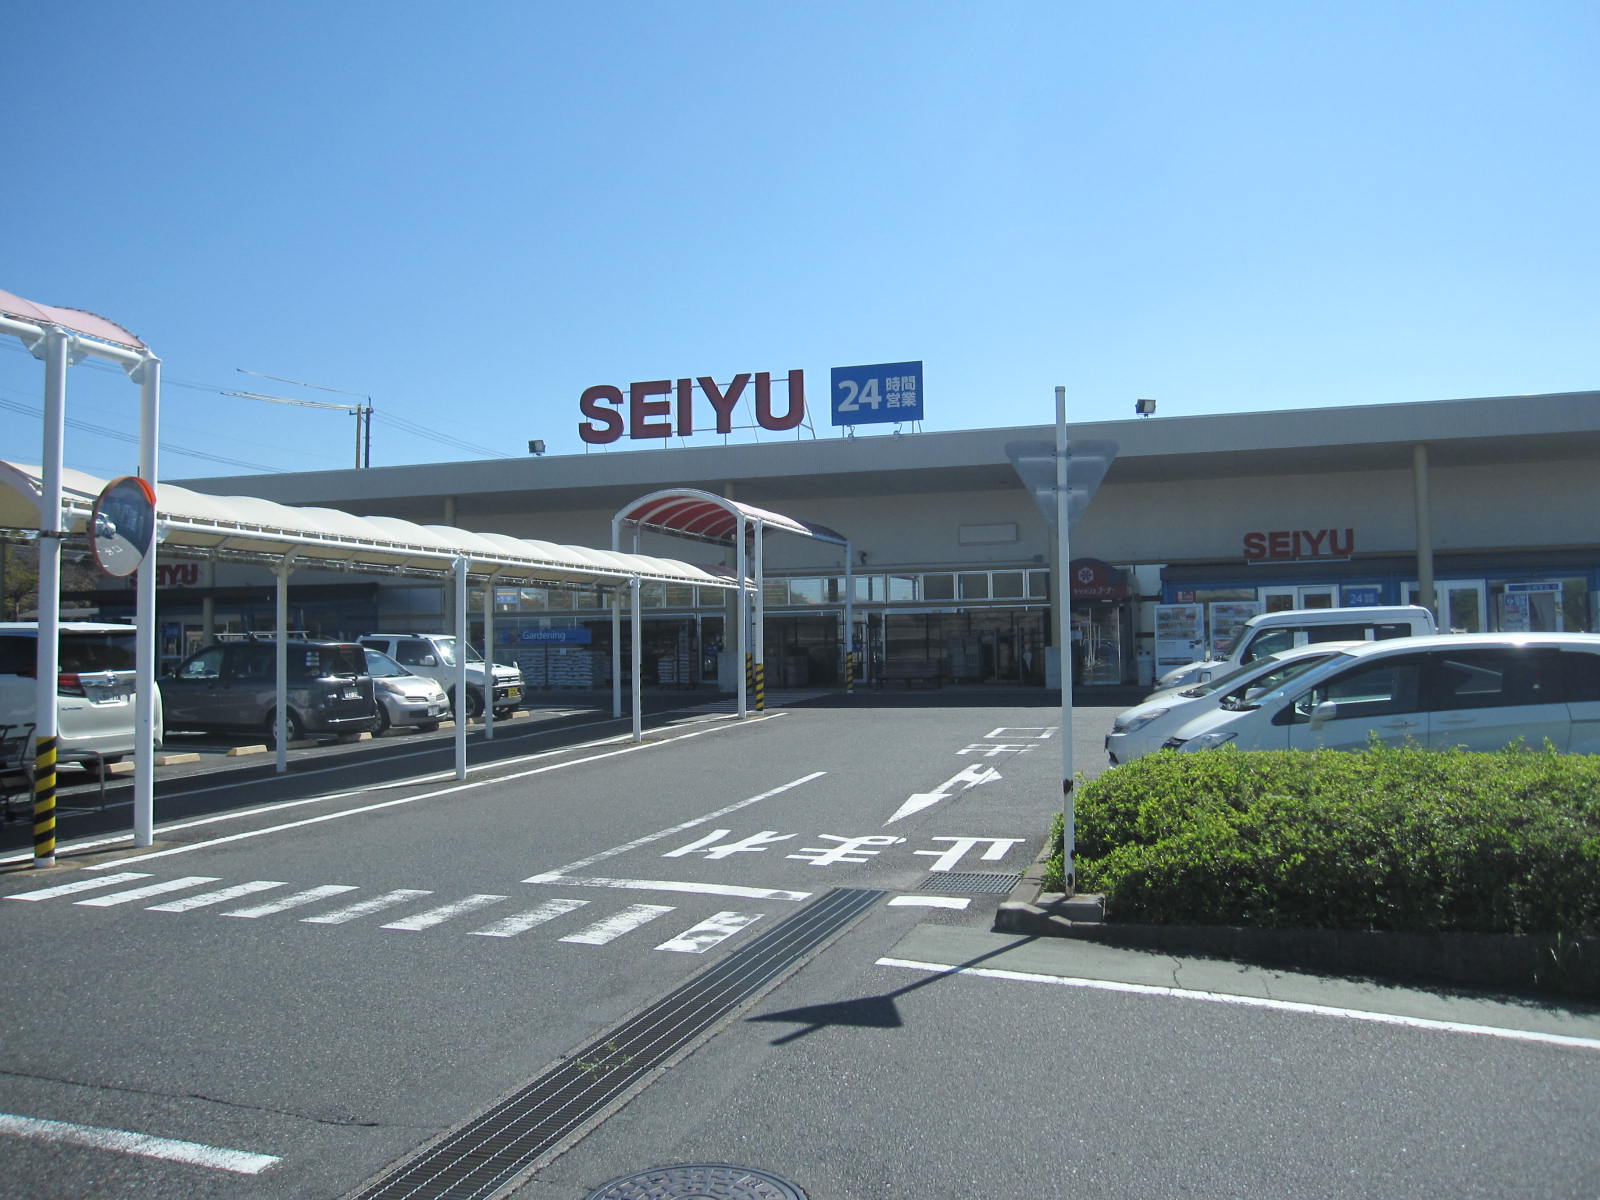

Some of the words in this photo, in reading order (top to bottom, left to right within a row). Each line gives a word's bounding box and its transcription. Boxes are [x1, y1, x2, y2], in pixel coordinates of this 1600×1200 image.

[578, 369, 804, 444] SEIYU
[837, 378, 882, 412] 24
[886, 375, 916, 392] 時間
[886, 392, 917, 409] 営業
[1243, 528, 1355, 559] SEIYU
[522, 630, 566, 642] Gardening
[661, 829, 1026, 872] 止まれ
